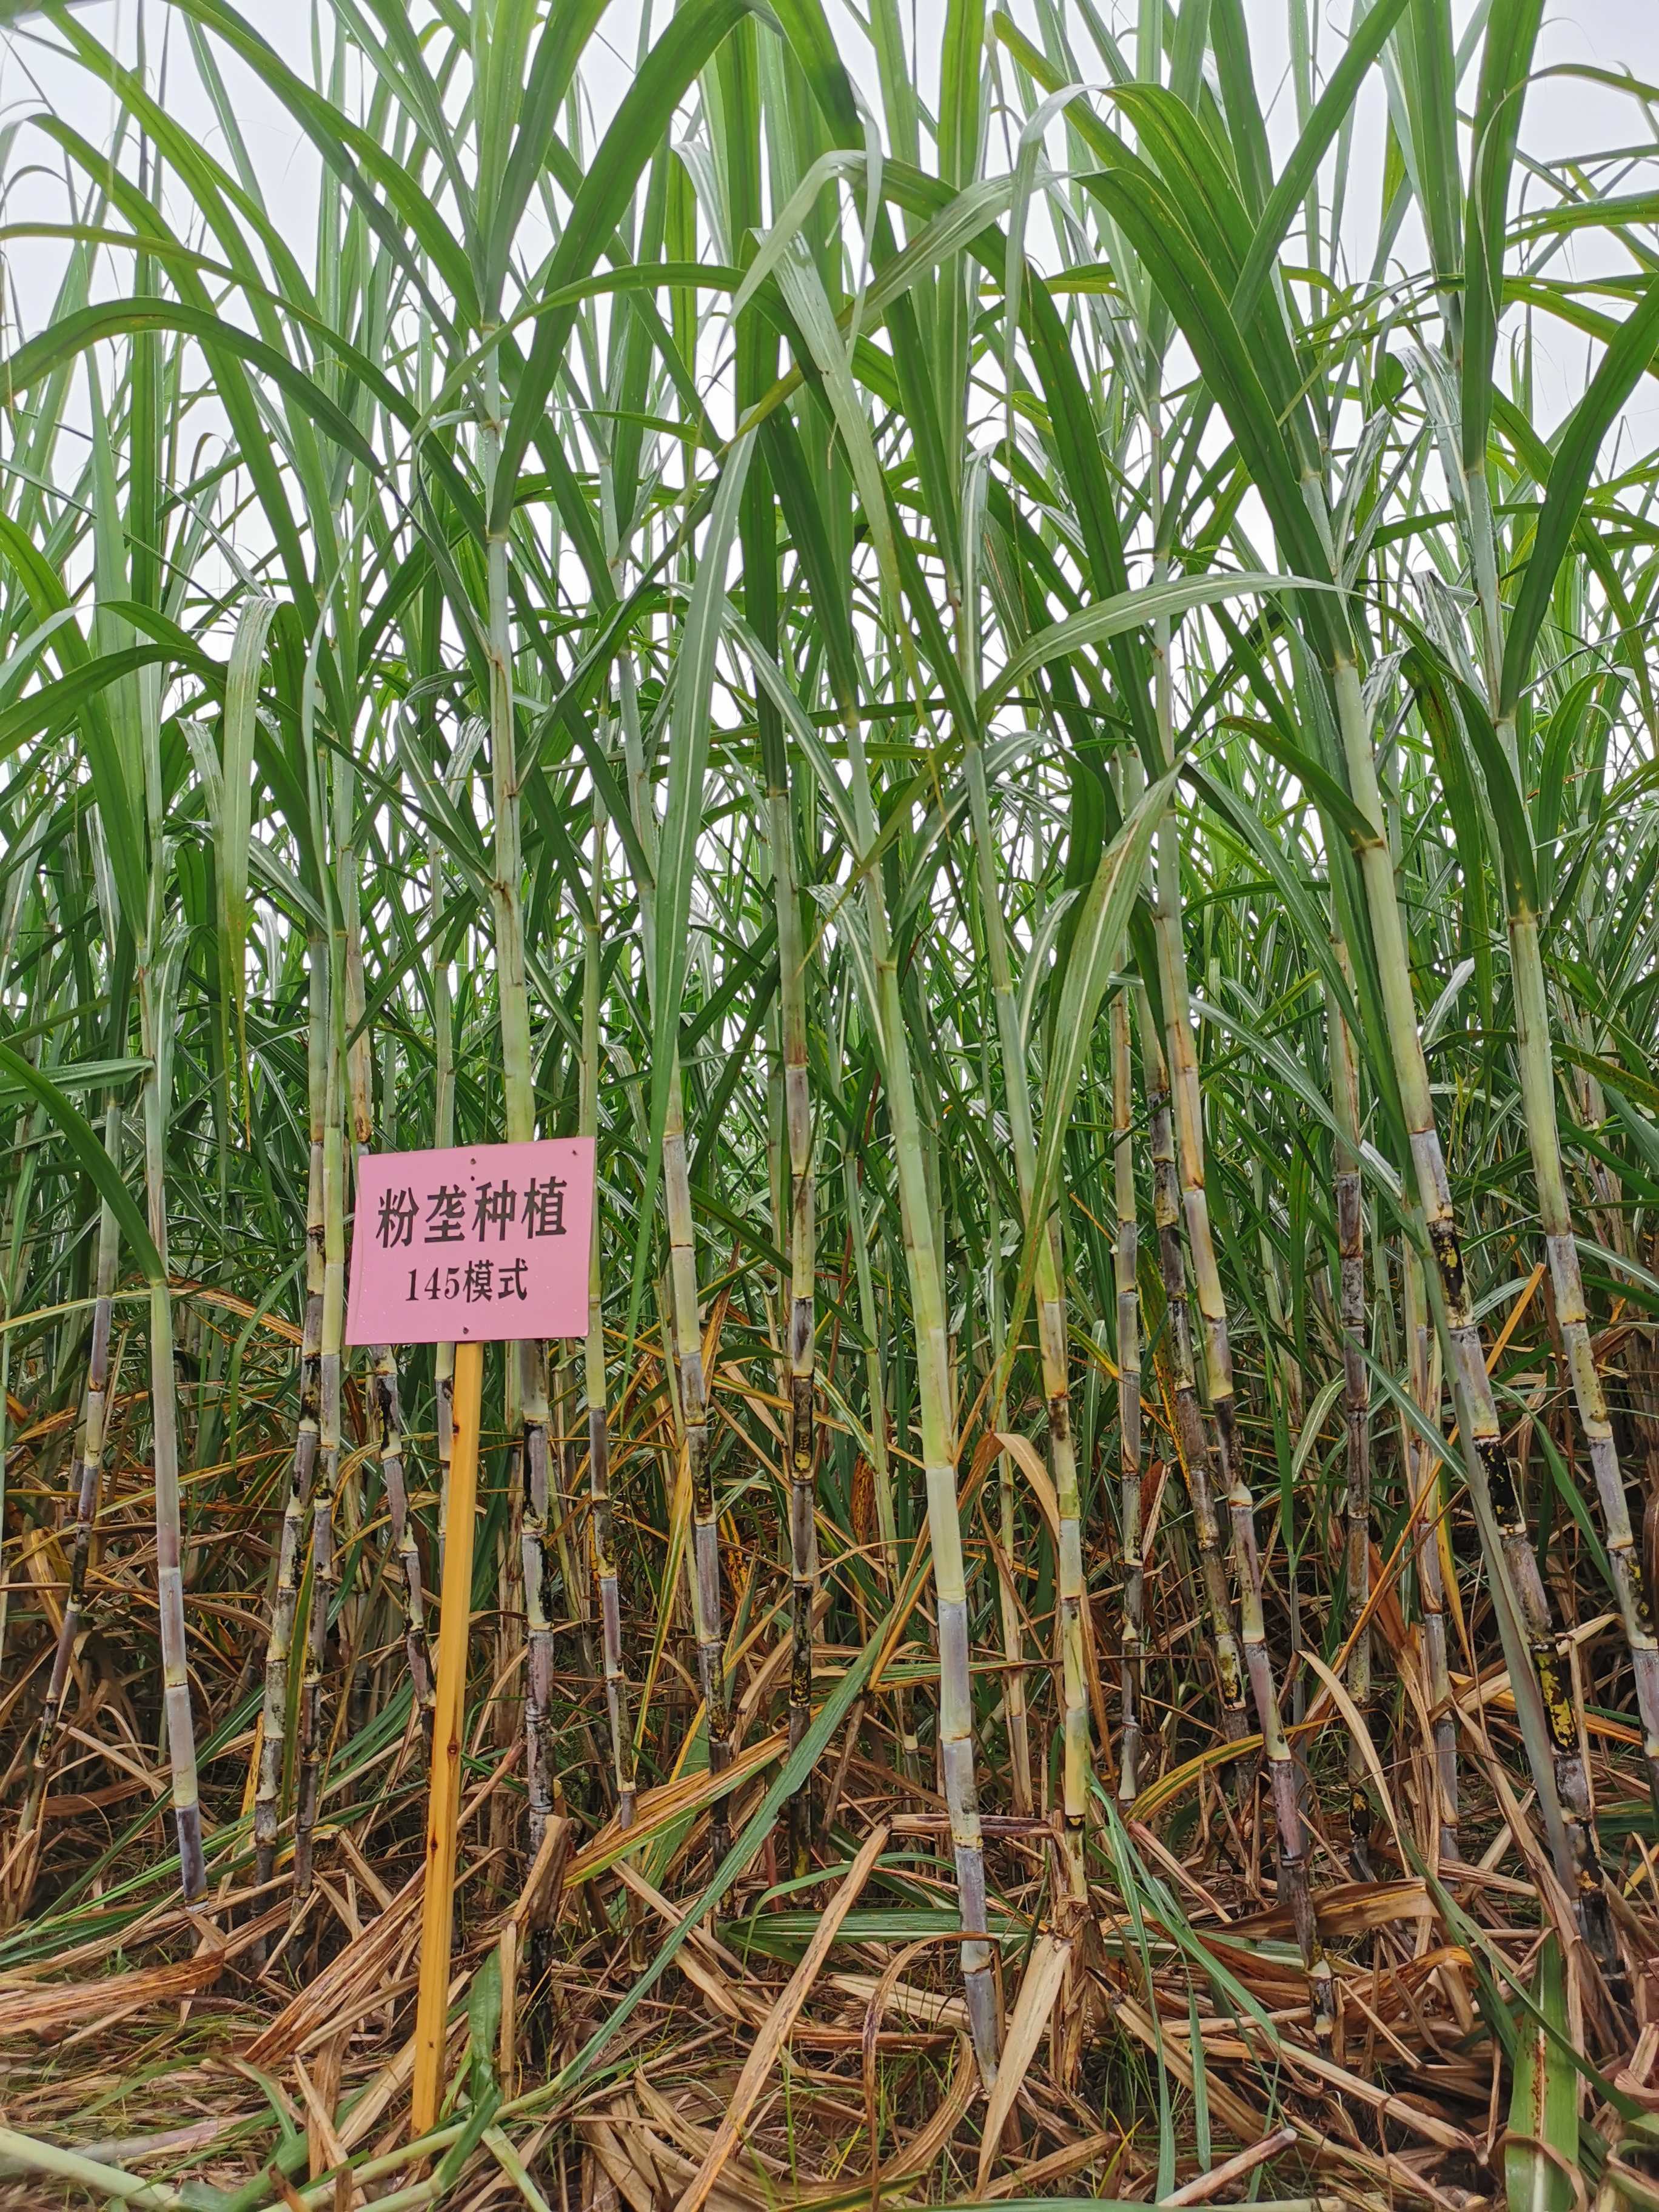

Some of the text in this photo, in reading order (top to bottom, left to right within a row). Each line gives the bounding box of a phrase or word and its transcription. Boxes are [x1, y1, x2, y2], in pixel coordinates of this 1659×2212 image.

[375, 1176, 568, 1248] 粉垄种植
[405, 1258, 529, 1303] 145模式
